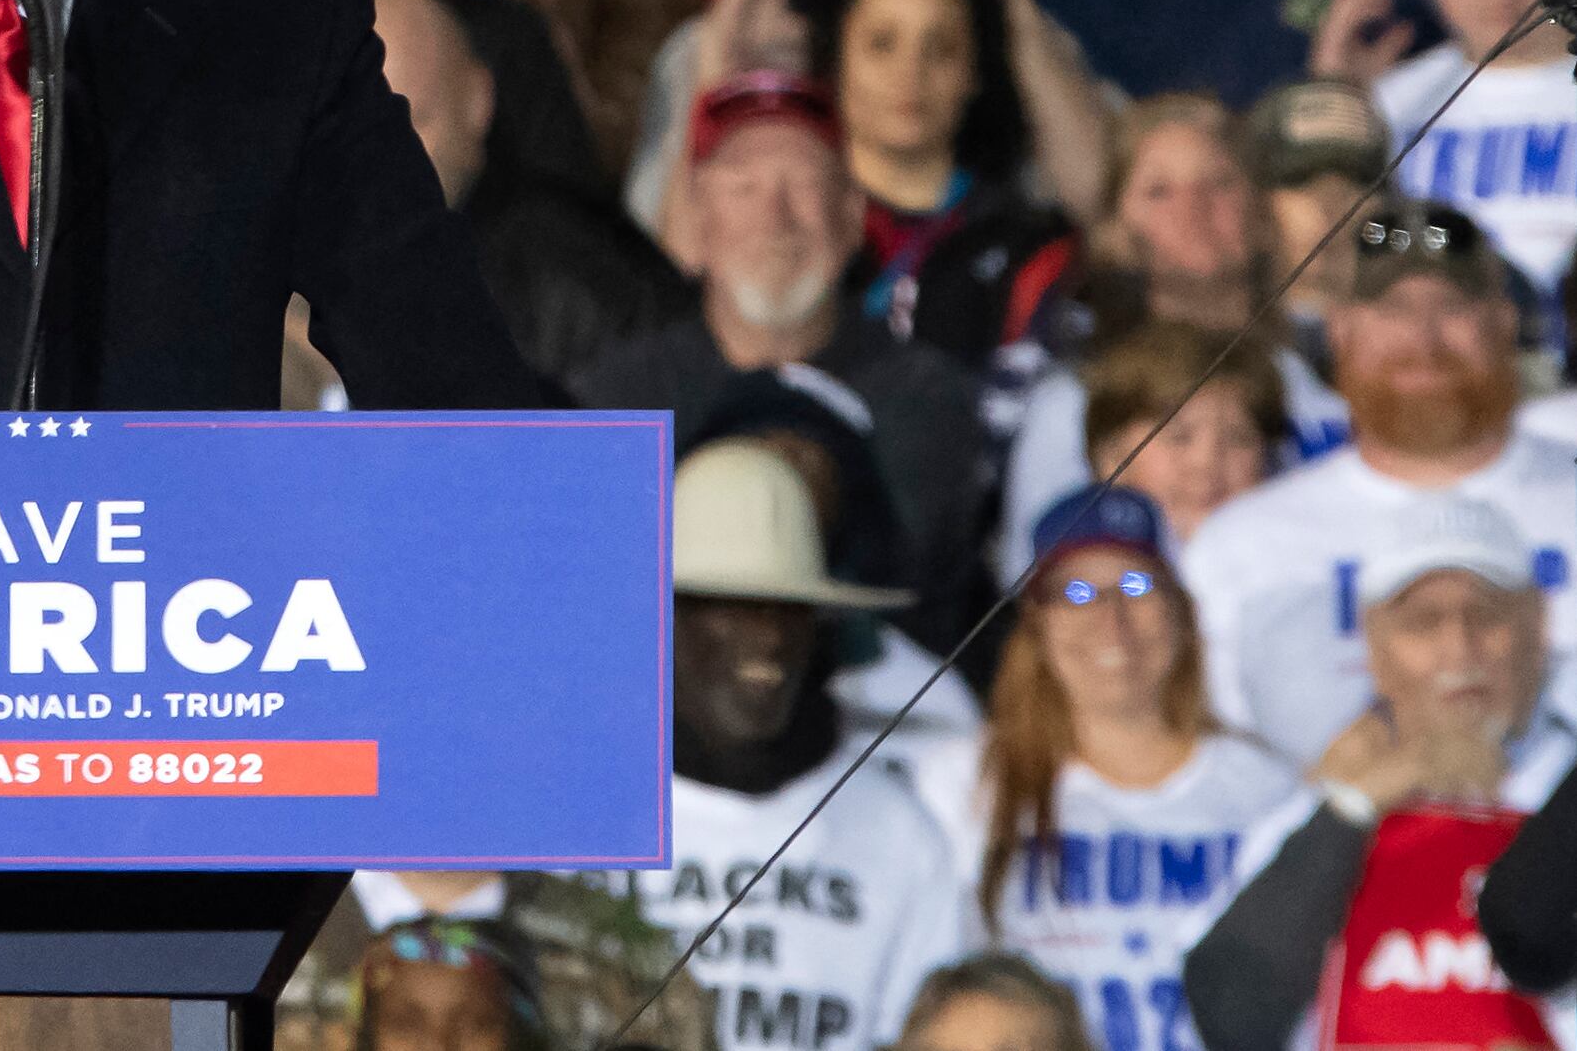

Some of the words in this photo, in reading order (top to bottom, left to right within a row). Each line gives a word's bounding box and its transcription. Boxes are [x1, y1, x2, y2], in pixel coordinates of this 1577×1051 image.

[124, 693, 152, 719] J.
[163, 692, 285, 718] TRUMP
[55, 753, 113, 785] TO
[128, 753, 264, 784] 88022
